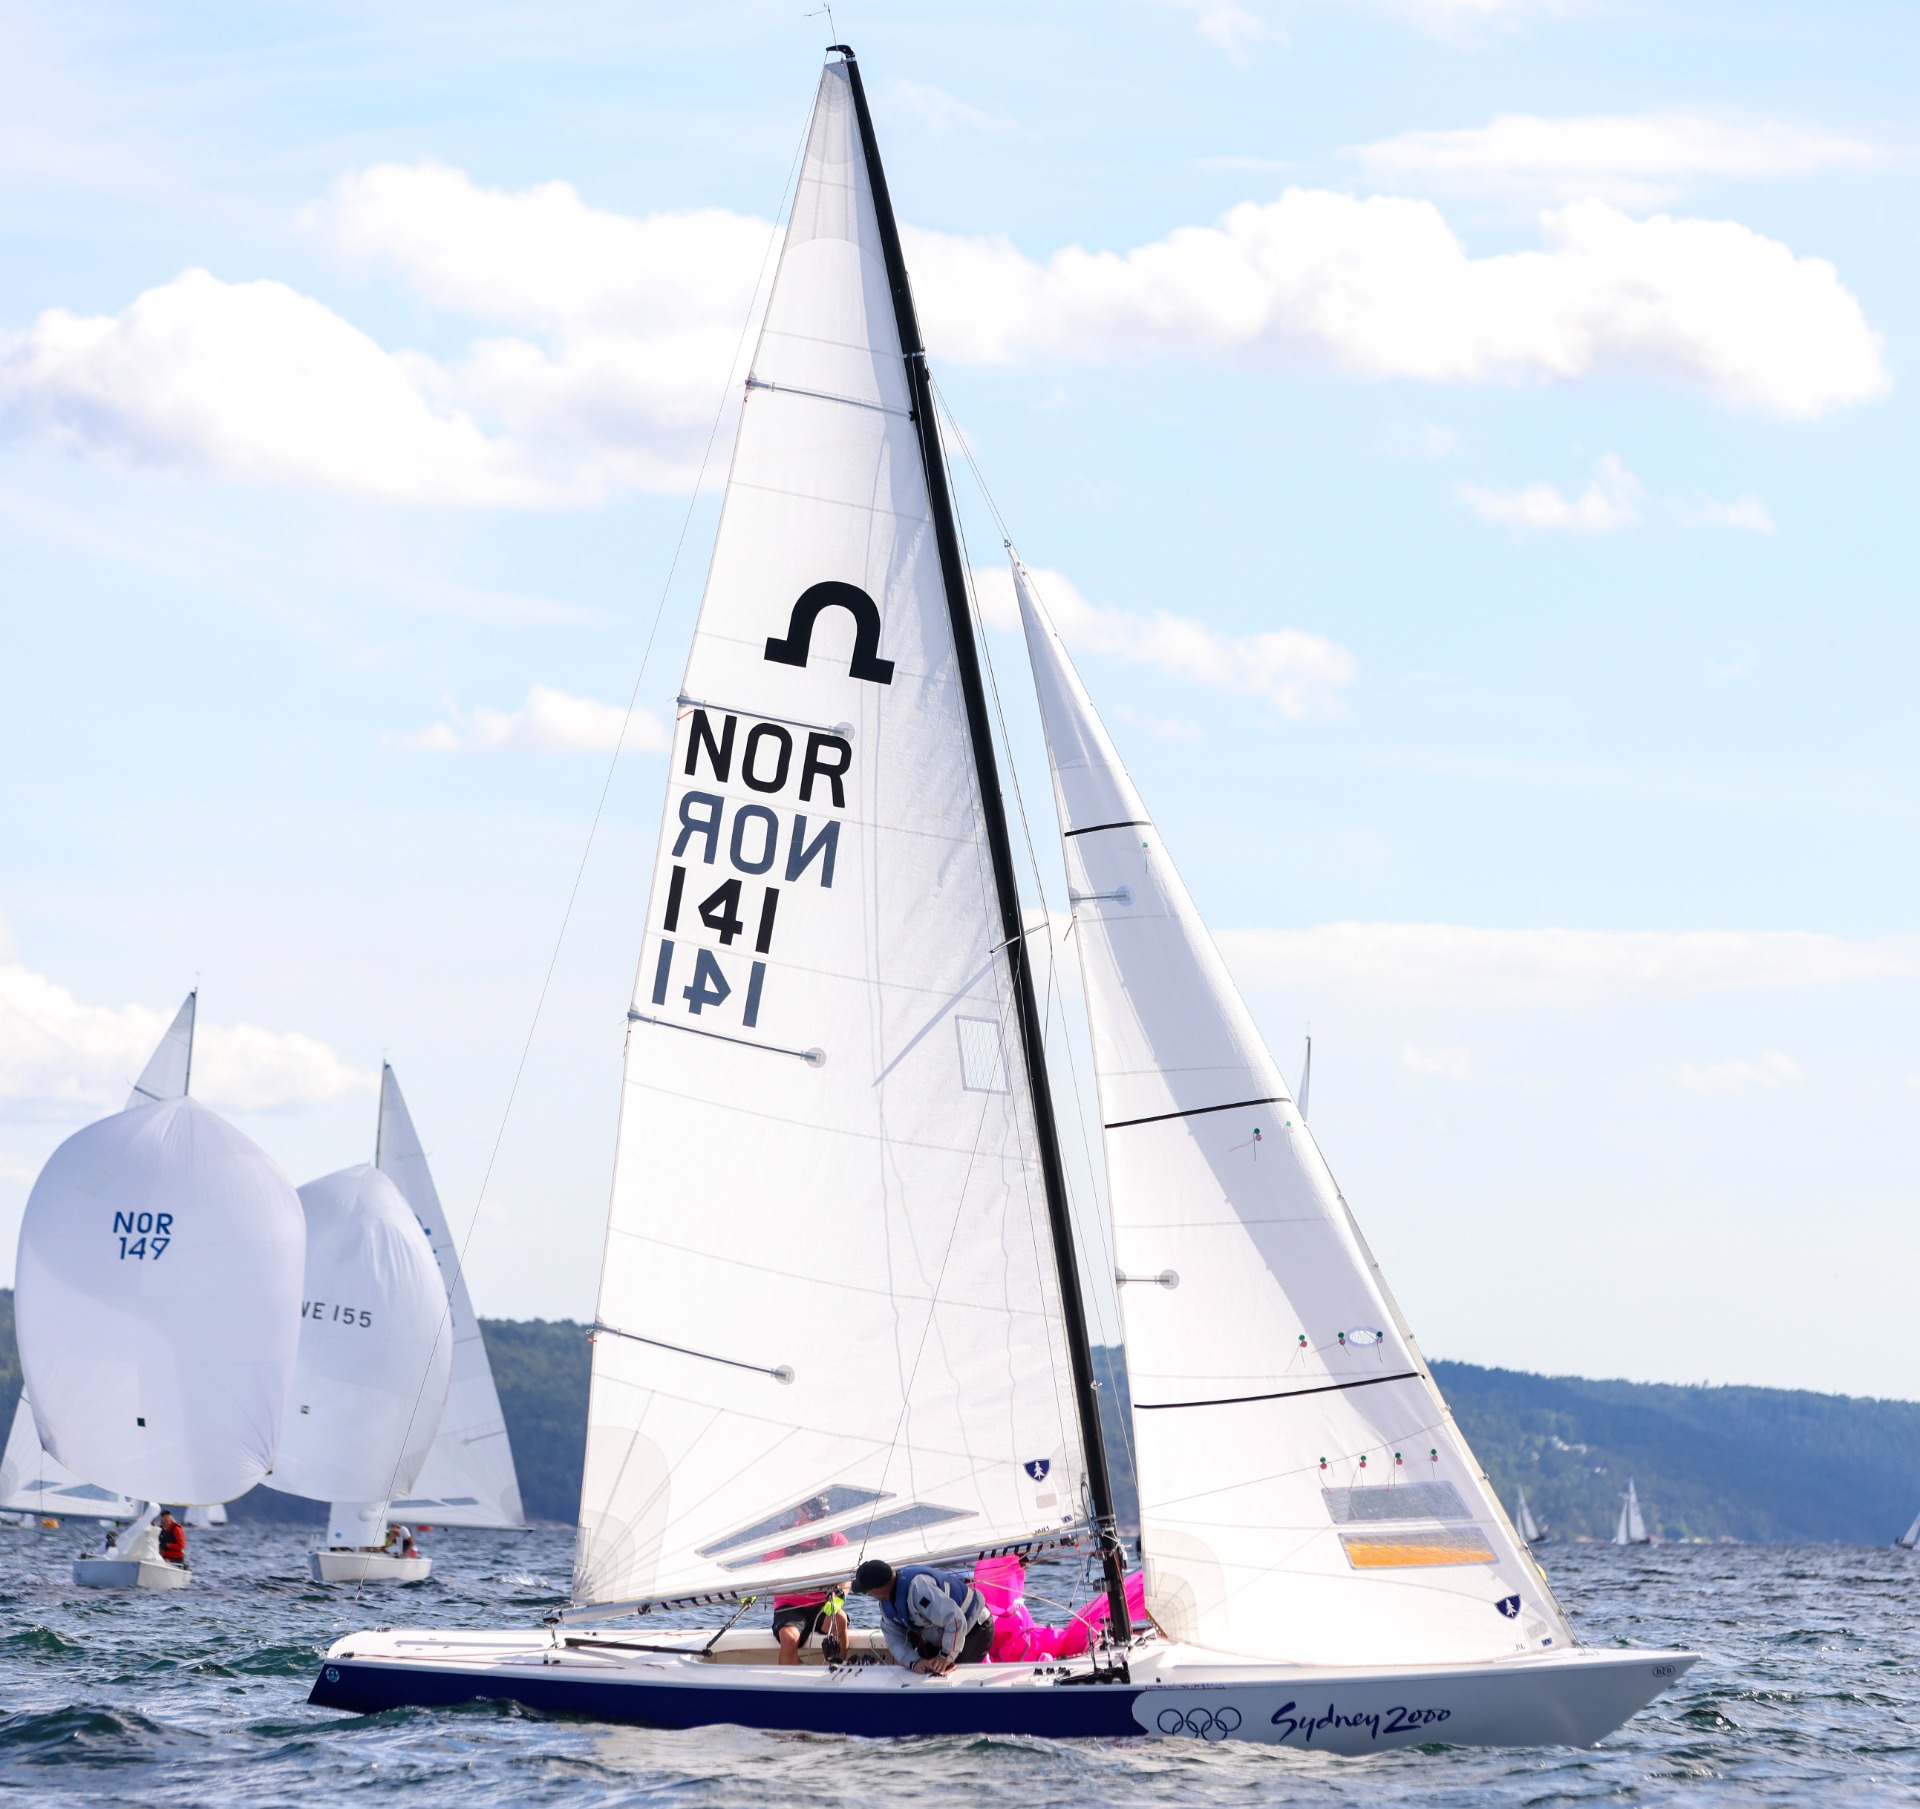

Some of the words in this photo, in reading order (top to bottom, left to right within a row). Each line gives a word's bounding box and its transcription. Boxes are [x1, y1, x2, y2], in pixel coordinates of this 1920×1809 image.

[684, 708, 853, 809] NOR
[663, 864, 780, 955] 141
[113, 1211, 173, 1235] NOR
[119, 1237, 171, 1260] 149
[333, 1304, 372, 1329] 155
[1271, 1701, 1380, 1742] Sydney
[1383, 1706, 1452, 1734] 2000
